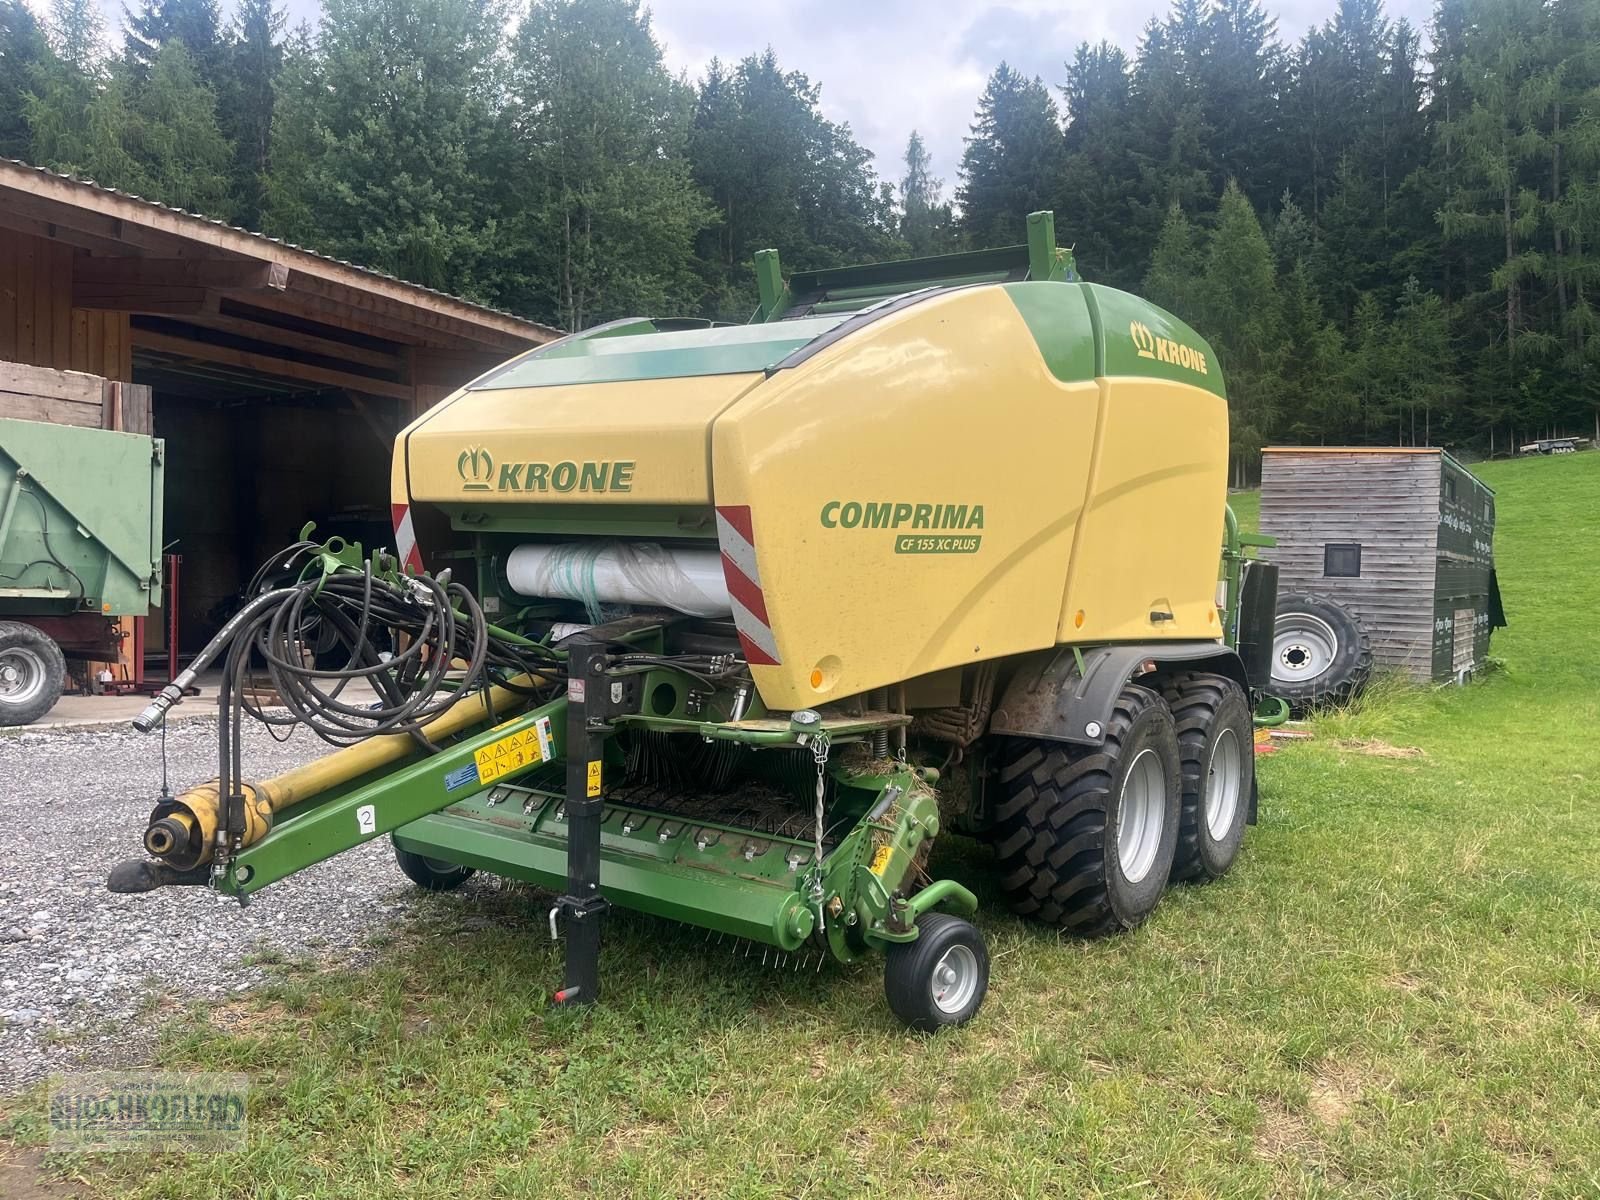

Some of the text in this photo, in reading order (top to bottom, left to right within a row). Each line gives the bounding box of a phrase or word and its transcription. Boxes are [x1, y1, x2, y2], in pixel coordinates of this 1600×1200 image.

[1156, 337, 1208, 375] KRONE
[498, 461, 635, 491] KRONE
[820, 501, 984, 529] COMPRIMA
[900, 538, 977, 551] CF 155 XC PLUS
[361, 810, 373, 826] 2
